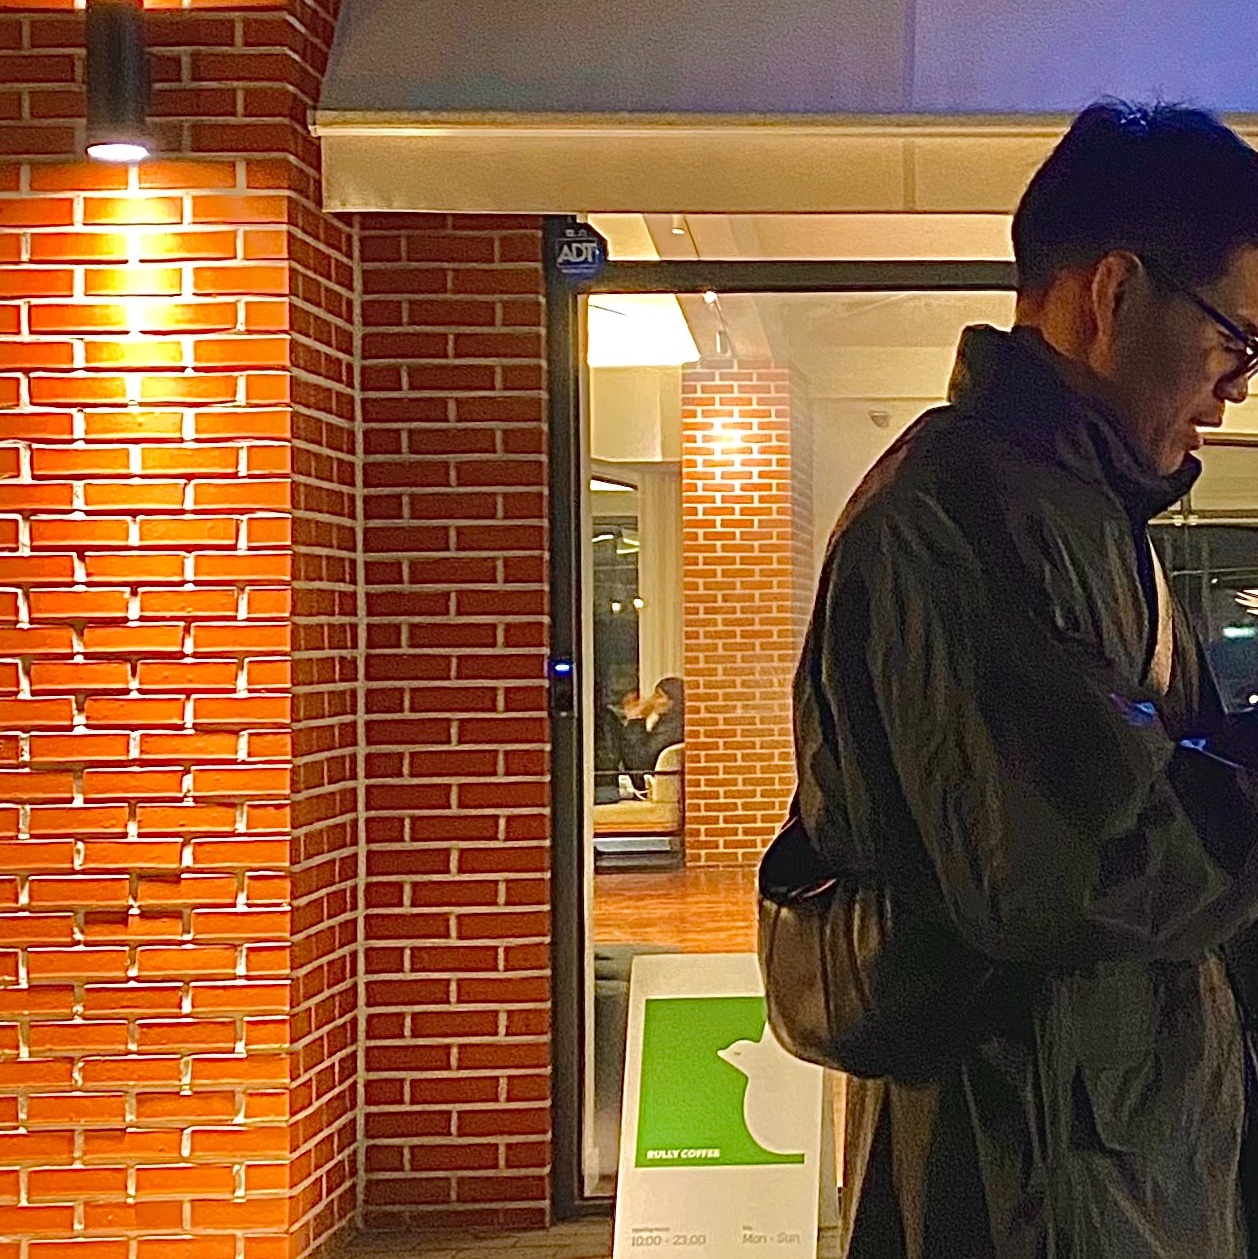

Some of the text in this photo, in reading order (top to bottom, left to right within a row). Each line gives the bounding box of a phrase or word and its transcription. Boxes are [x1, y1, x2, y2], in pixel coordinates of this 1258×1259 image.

[557, 242, 597, 262] ADT
[646, 1148, 721, 1159] RULLY COFFEE
[632, 1235, 661, 1247] 10:00
[673, 1234, 706, 1246] 23:00
[742, 1233, 767, 1244] Mon
[777, 1231, 800, 1244] Sun
